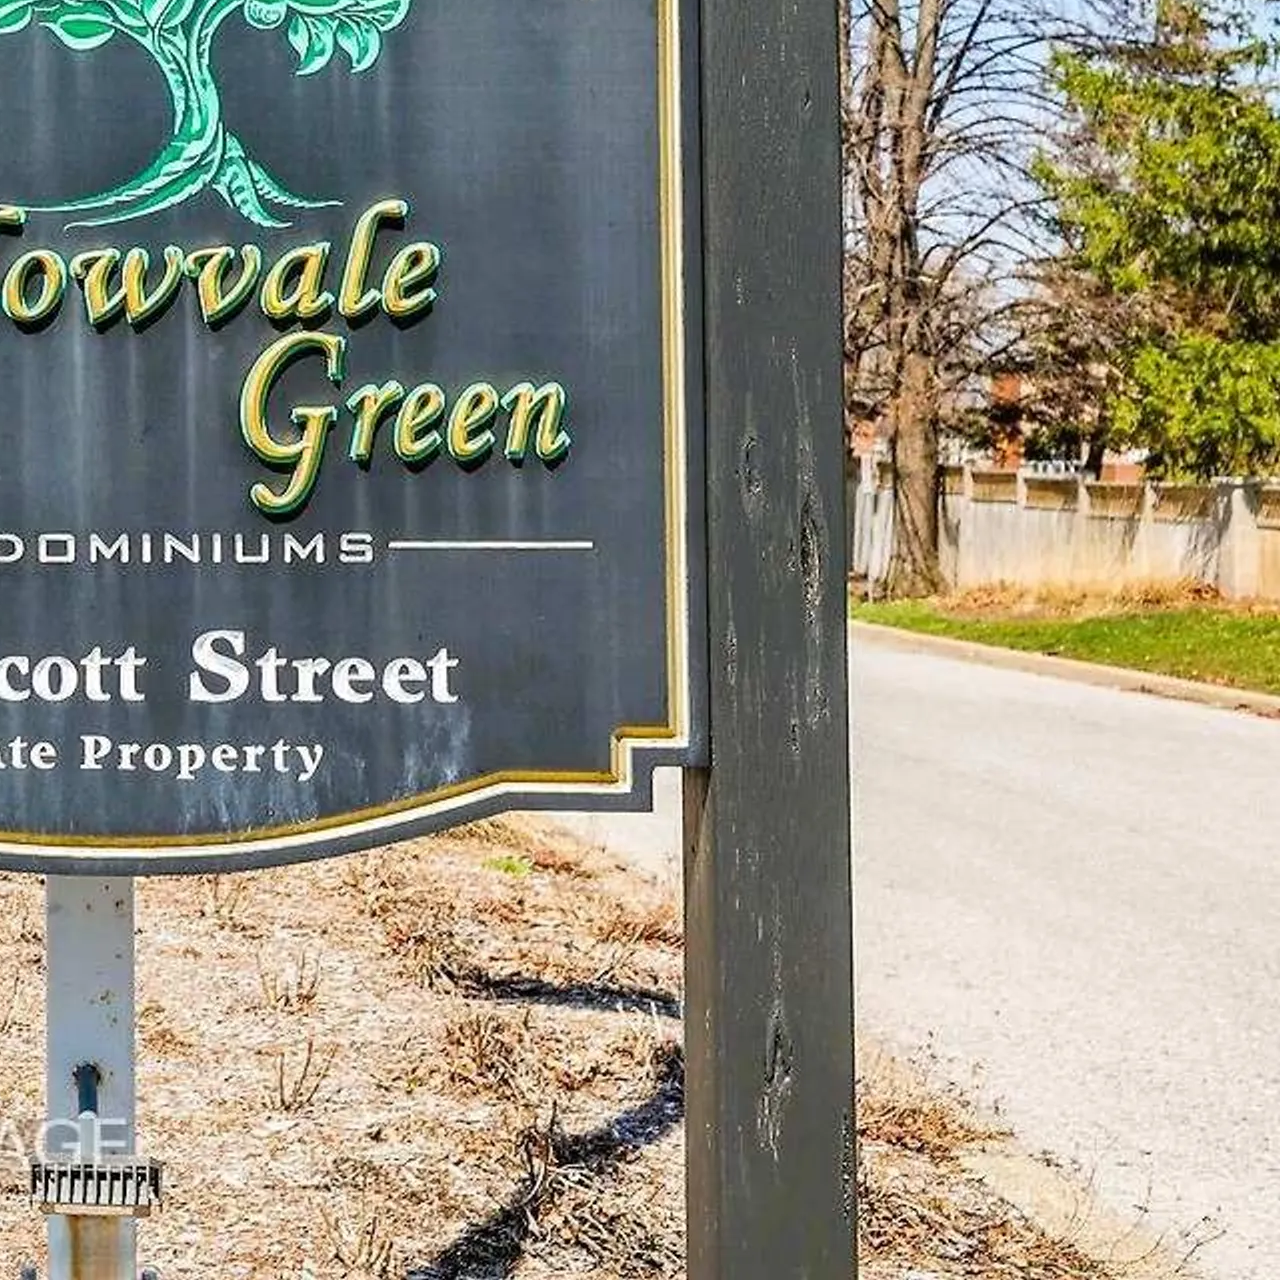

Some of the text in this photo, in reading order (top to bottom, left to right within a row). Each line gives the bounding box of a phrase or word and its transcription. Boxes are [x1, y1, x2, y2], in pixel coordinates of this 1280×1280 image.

[241, 330, 571, 514] Green
[188, 629, 460, 703] Street
[79, 733, 325, 780] Property
